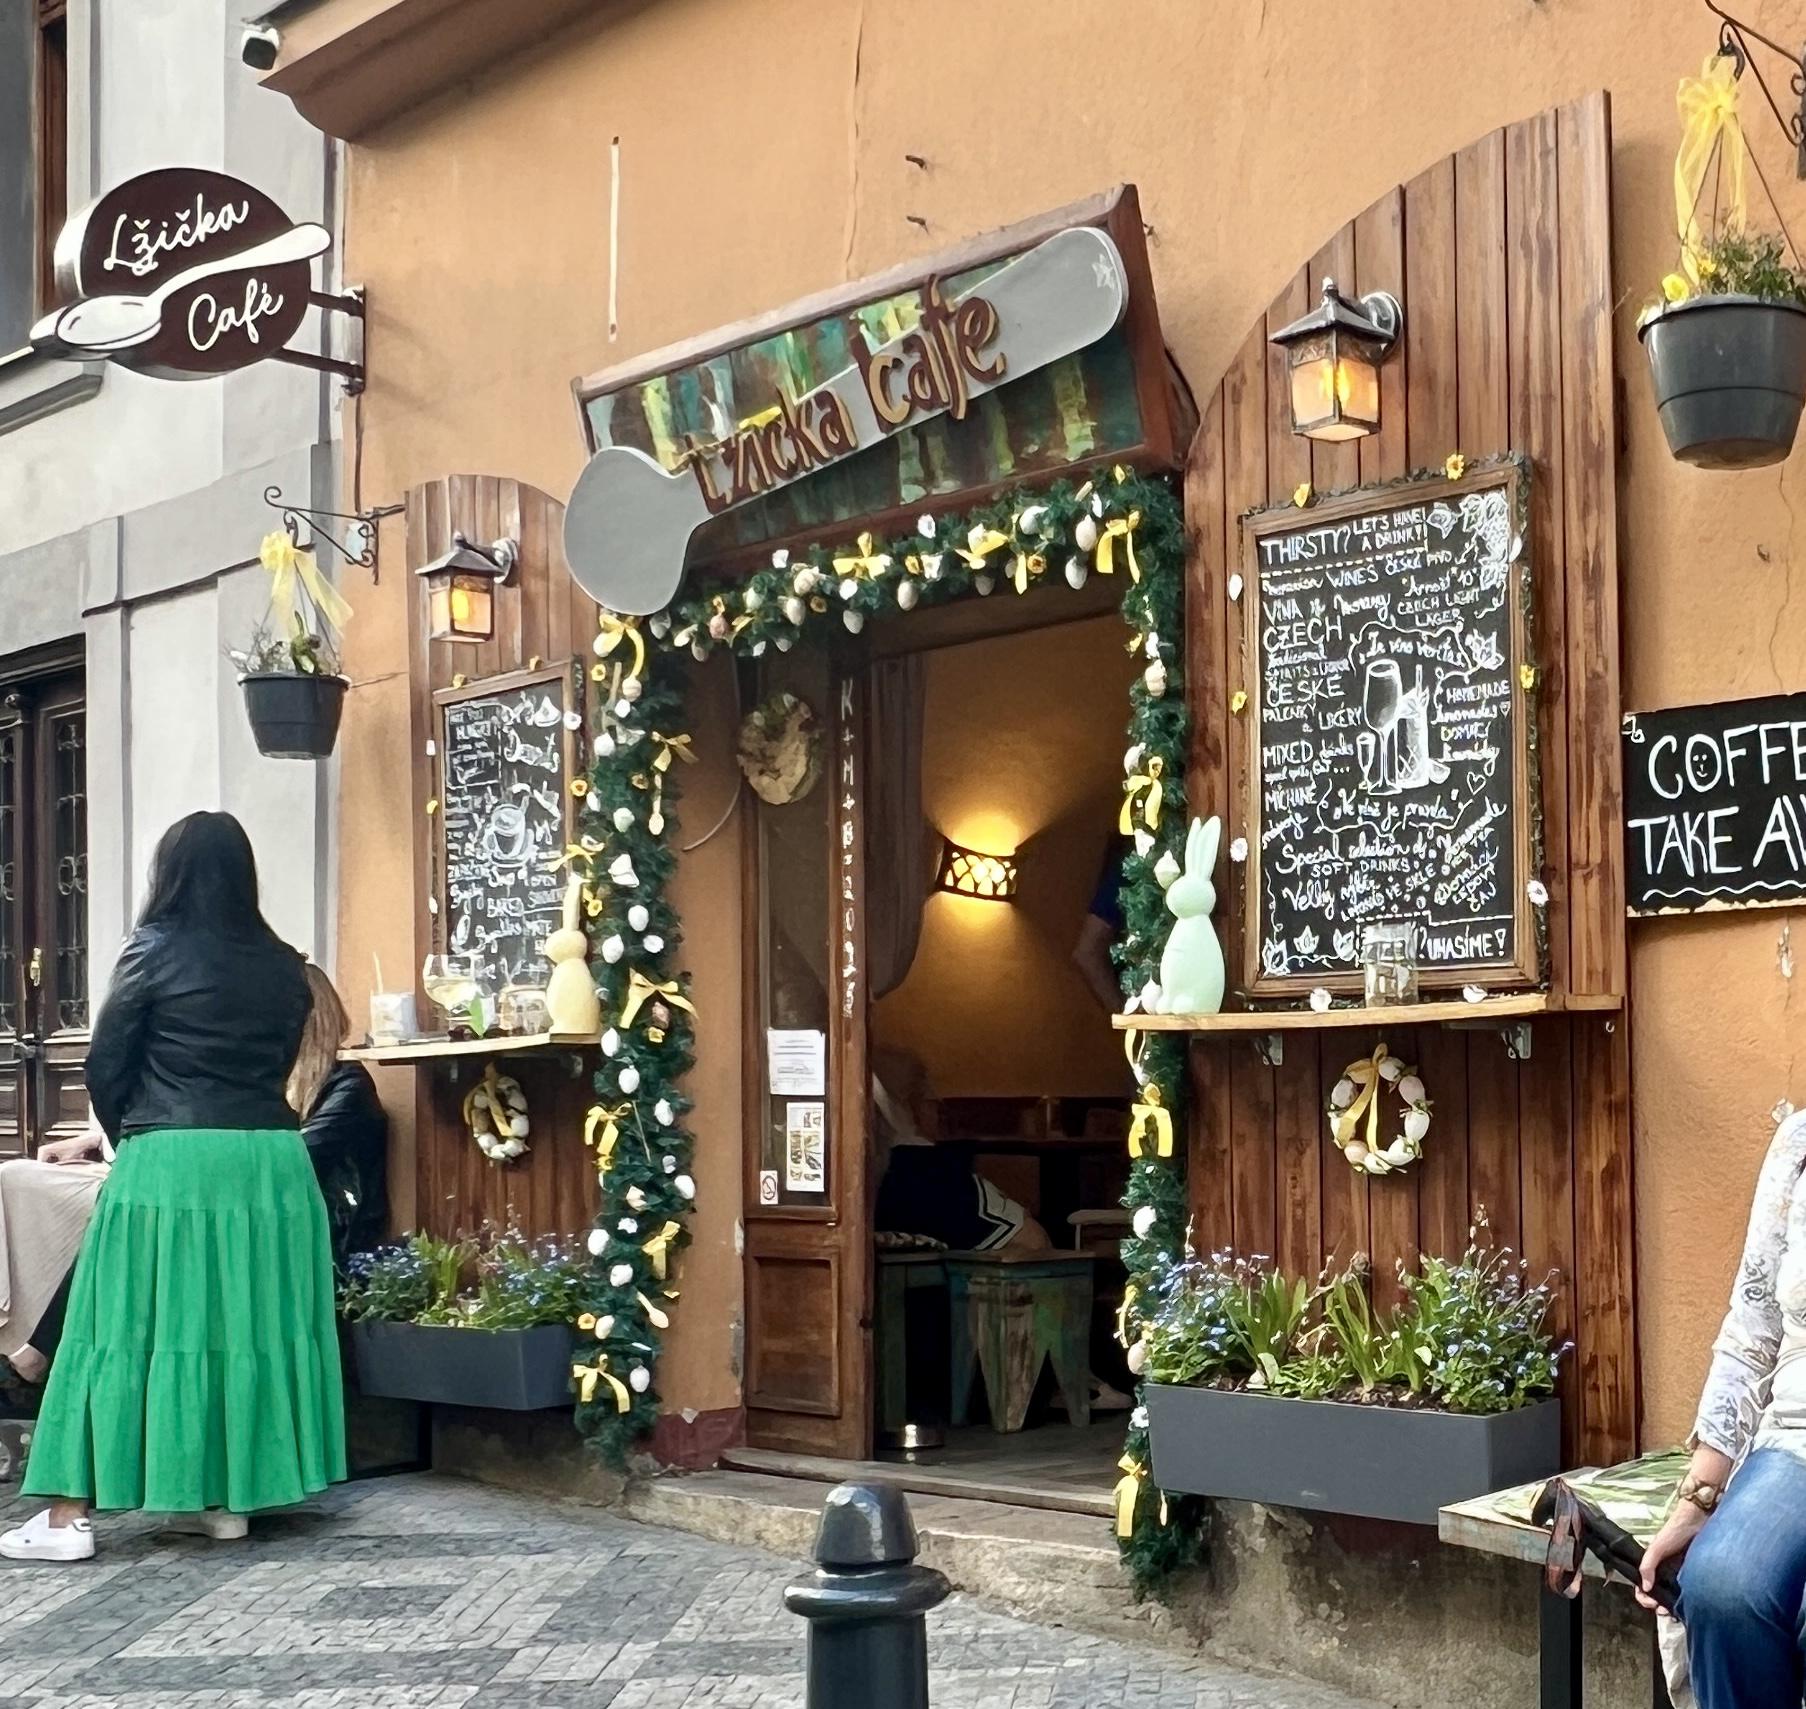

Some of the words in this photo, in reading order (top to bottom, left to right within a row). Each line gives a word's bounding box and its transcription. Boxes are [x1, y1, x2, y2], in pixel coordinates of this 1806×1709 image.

[103, 193, 250, 276] Lžička
[1263, 615, 1343, 652] CZECH
[1262, 740, 1314, 768] MIXED
[1628, 806, 1743, 877] TAKE
[1752, 793, 1806, 873] A
[1310, 860, 1353, 878] SOFT
